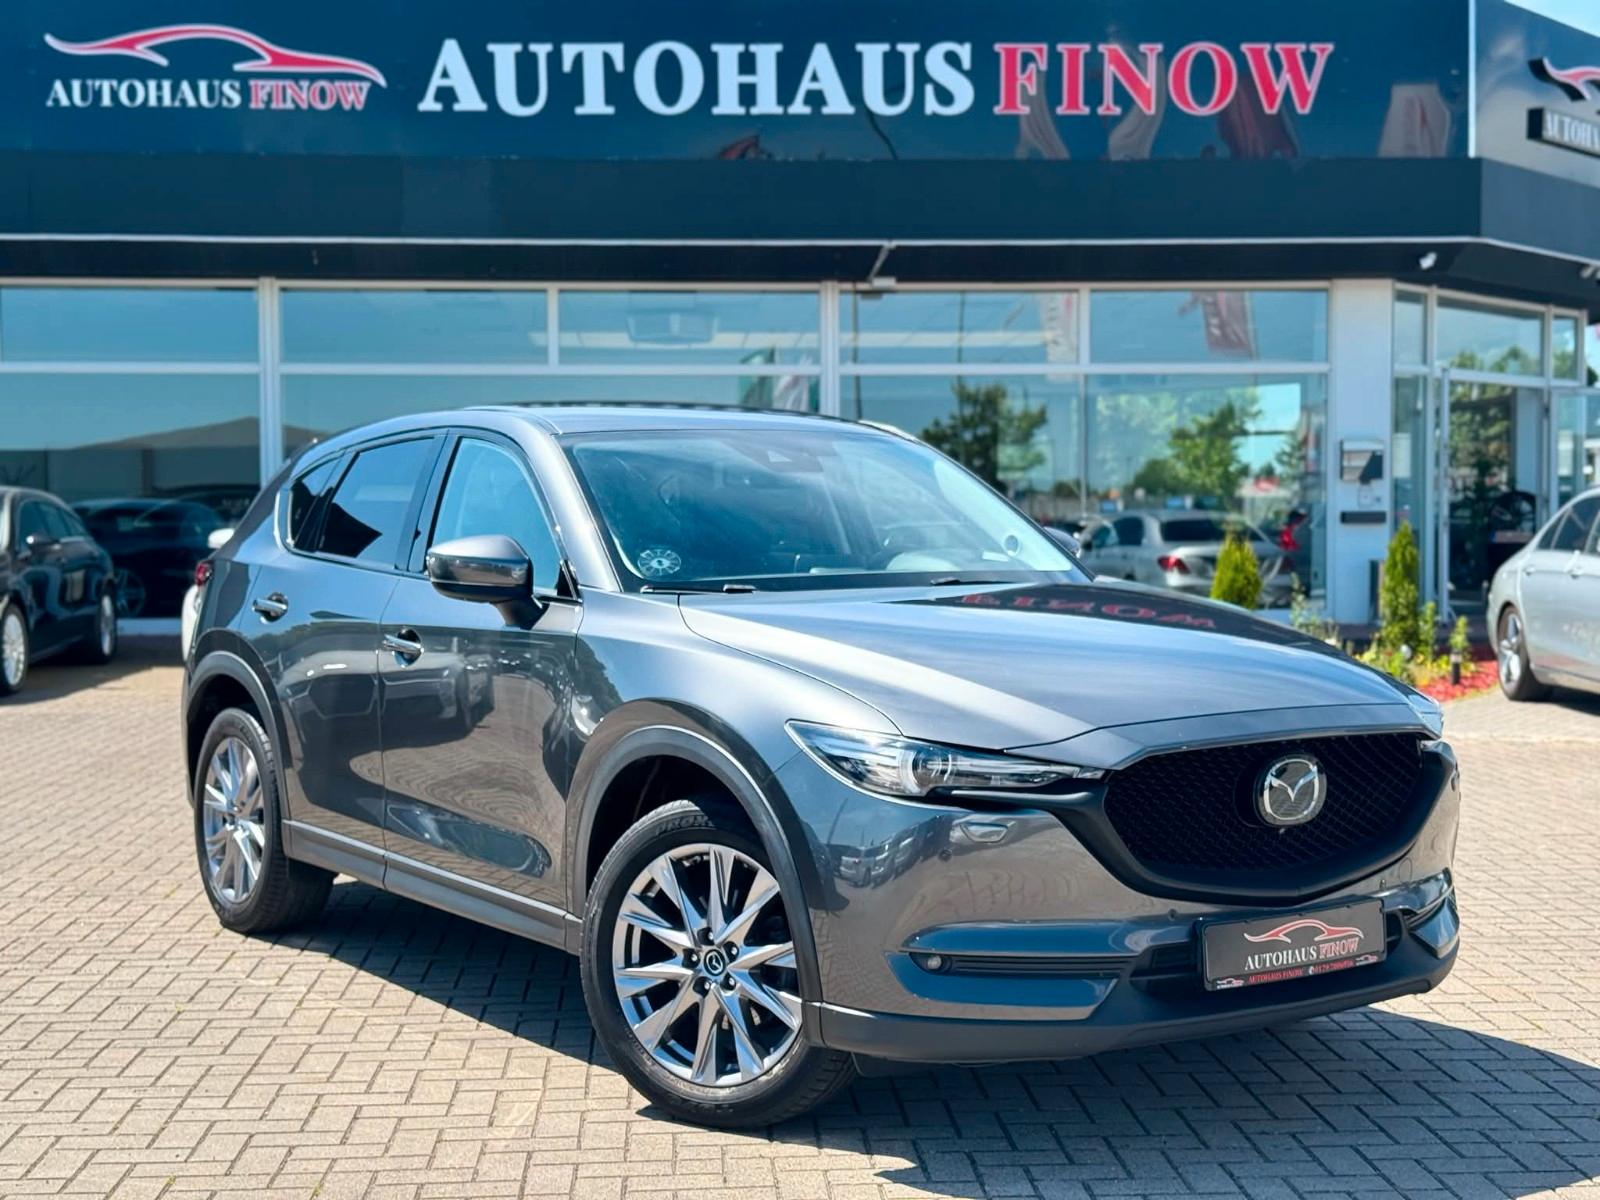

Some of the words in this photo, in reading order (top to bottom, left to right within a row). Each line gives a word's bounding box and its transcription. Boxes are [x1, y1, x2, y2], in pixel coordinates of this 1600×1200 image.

[46, 78, 242, 109] AUTOHAUS
[249, 79, 371, 111] FINOW
[417, 39, 974, 118] AUTOHAUS
[993, 41, 1335, 117] FINOW
[1244, 945, 1317, 971] AUTOHAUS
[1318, 937, 1360, 960] FINOW
